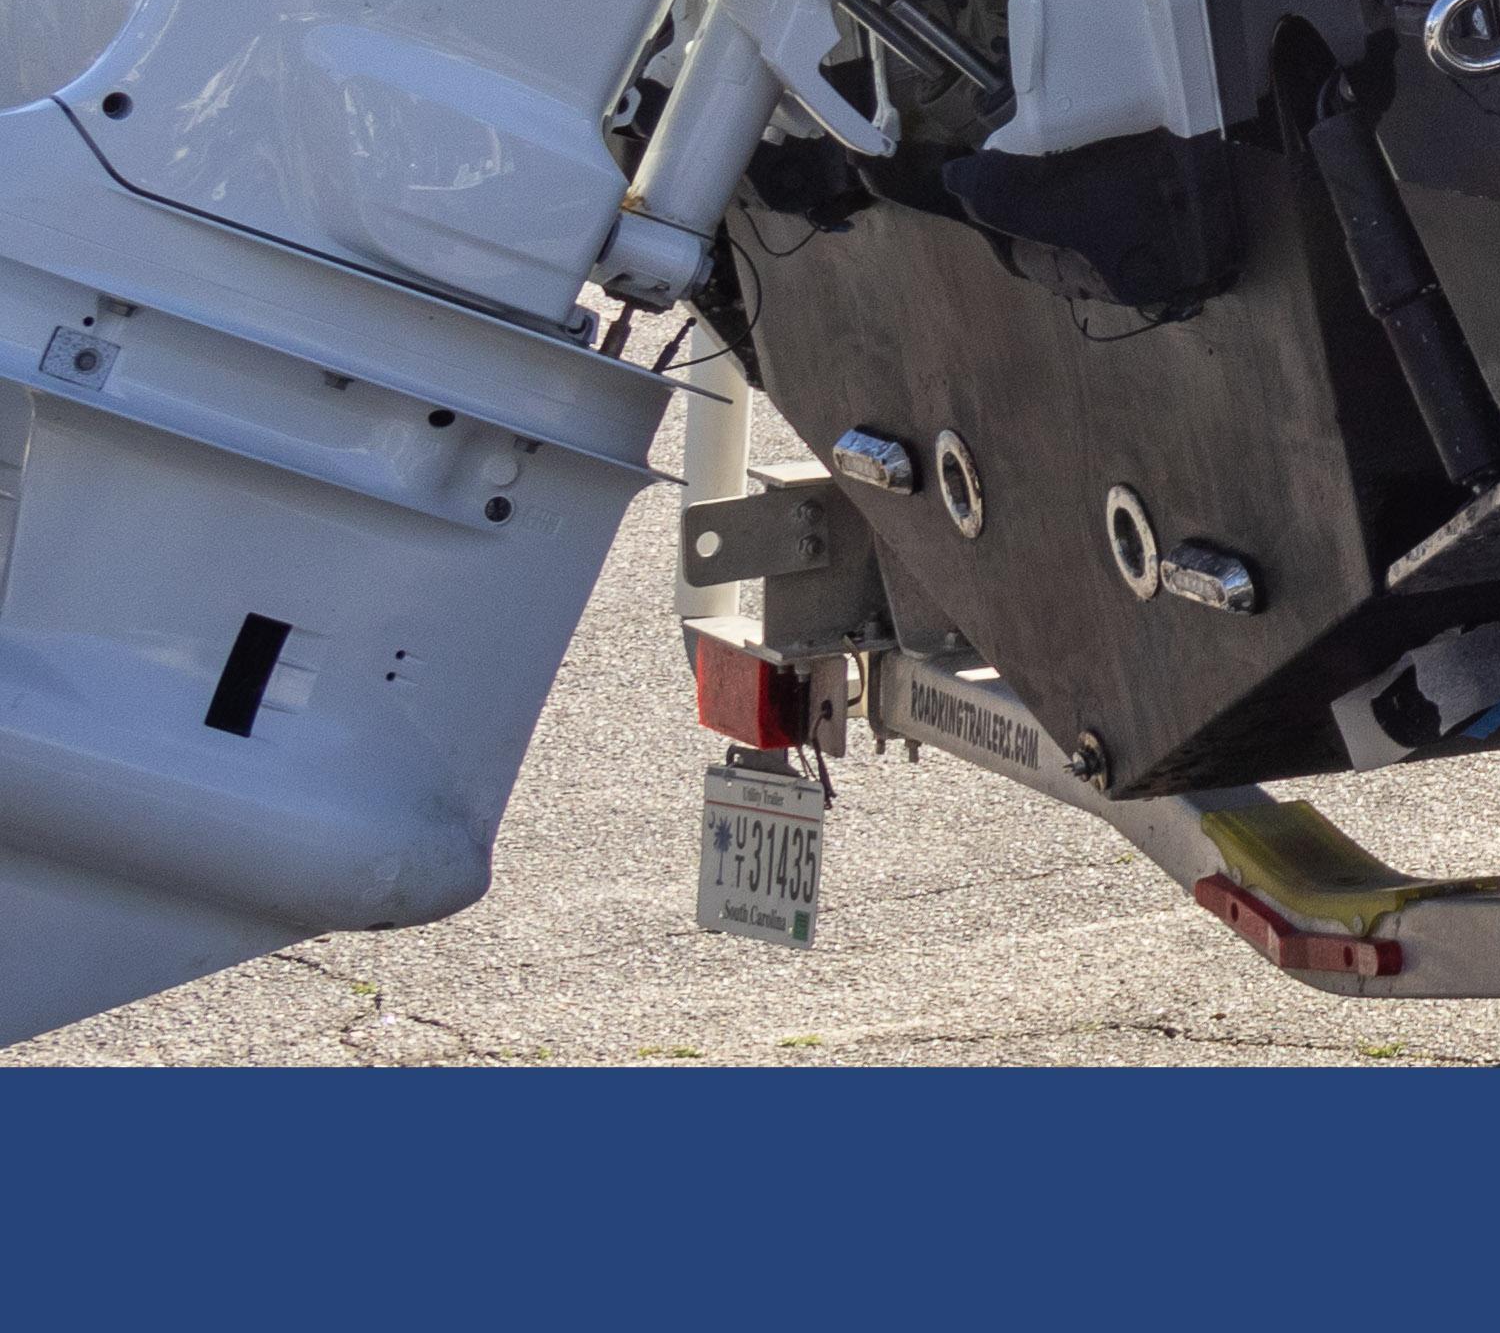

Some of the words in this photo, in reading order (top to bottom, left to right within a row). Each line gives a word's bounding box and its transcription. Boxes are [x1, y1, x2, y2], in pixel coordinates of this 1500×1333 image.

[910, 679, 1040, 771] ROADKINGTRAILERS.COM
[749, 819, 818, 904] 31435
[724, 899, 748, 923] South
[750, 904, 787, 932] Carolina
